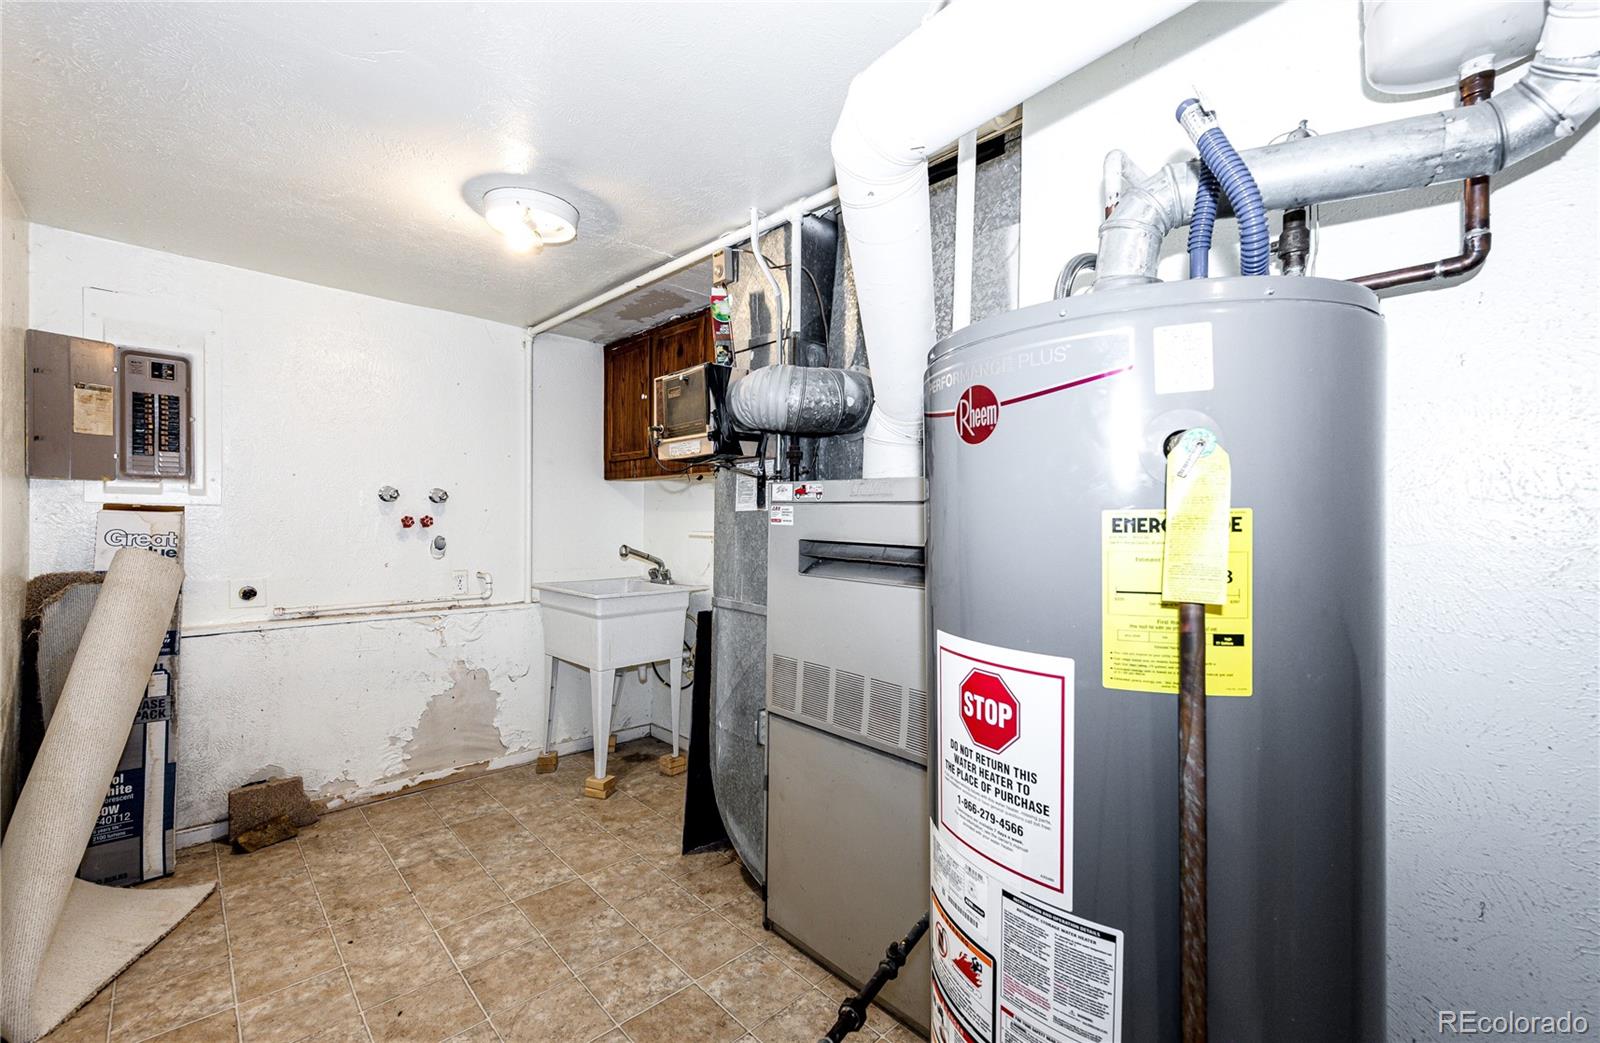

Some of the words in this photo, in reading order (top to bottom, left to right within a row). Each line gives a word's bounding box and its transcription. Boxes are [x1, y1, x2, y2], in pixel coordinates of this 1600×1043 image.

[960, 387, 997, 437] Rheem
[104, 528, 178, 548] Great
[142, 698, 166, 711] ASE
[963, 690, 1013, 729] STOP
[950, 738, 958, 752] DO
[960, 744, 973, 760] NOT
[975, 752, 1010, 775] RETURN
[1013, 766, 1038, 785] THIS
[953, 752, 977, 775] WATER
[979, 766, 1013, 790] HEATER
[1017, 781, 1030, 797] TO
[945, 758, 955, 775] THE
[956, 768, 979, 789] PLACE
[981, 781, 992, 794] OF
[994, 787, 1050, 817] PURCHASE
[101, 803, 120, 817] 0W
[957, 794, 1024, 837] 1-866-279-4566
